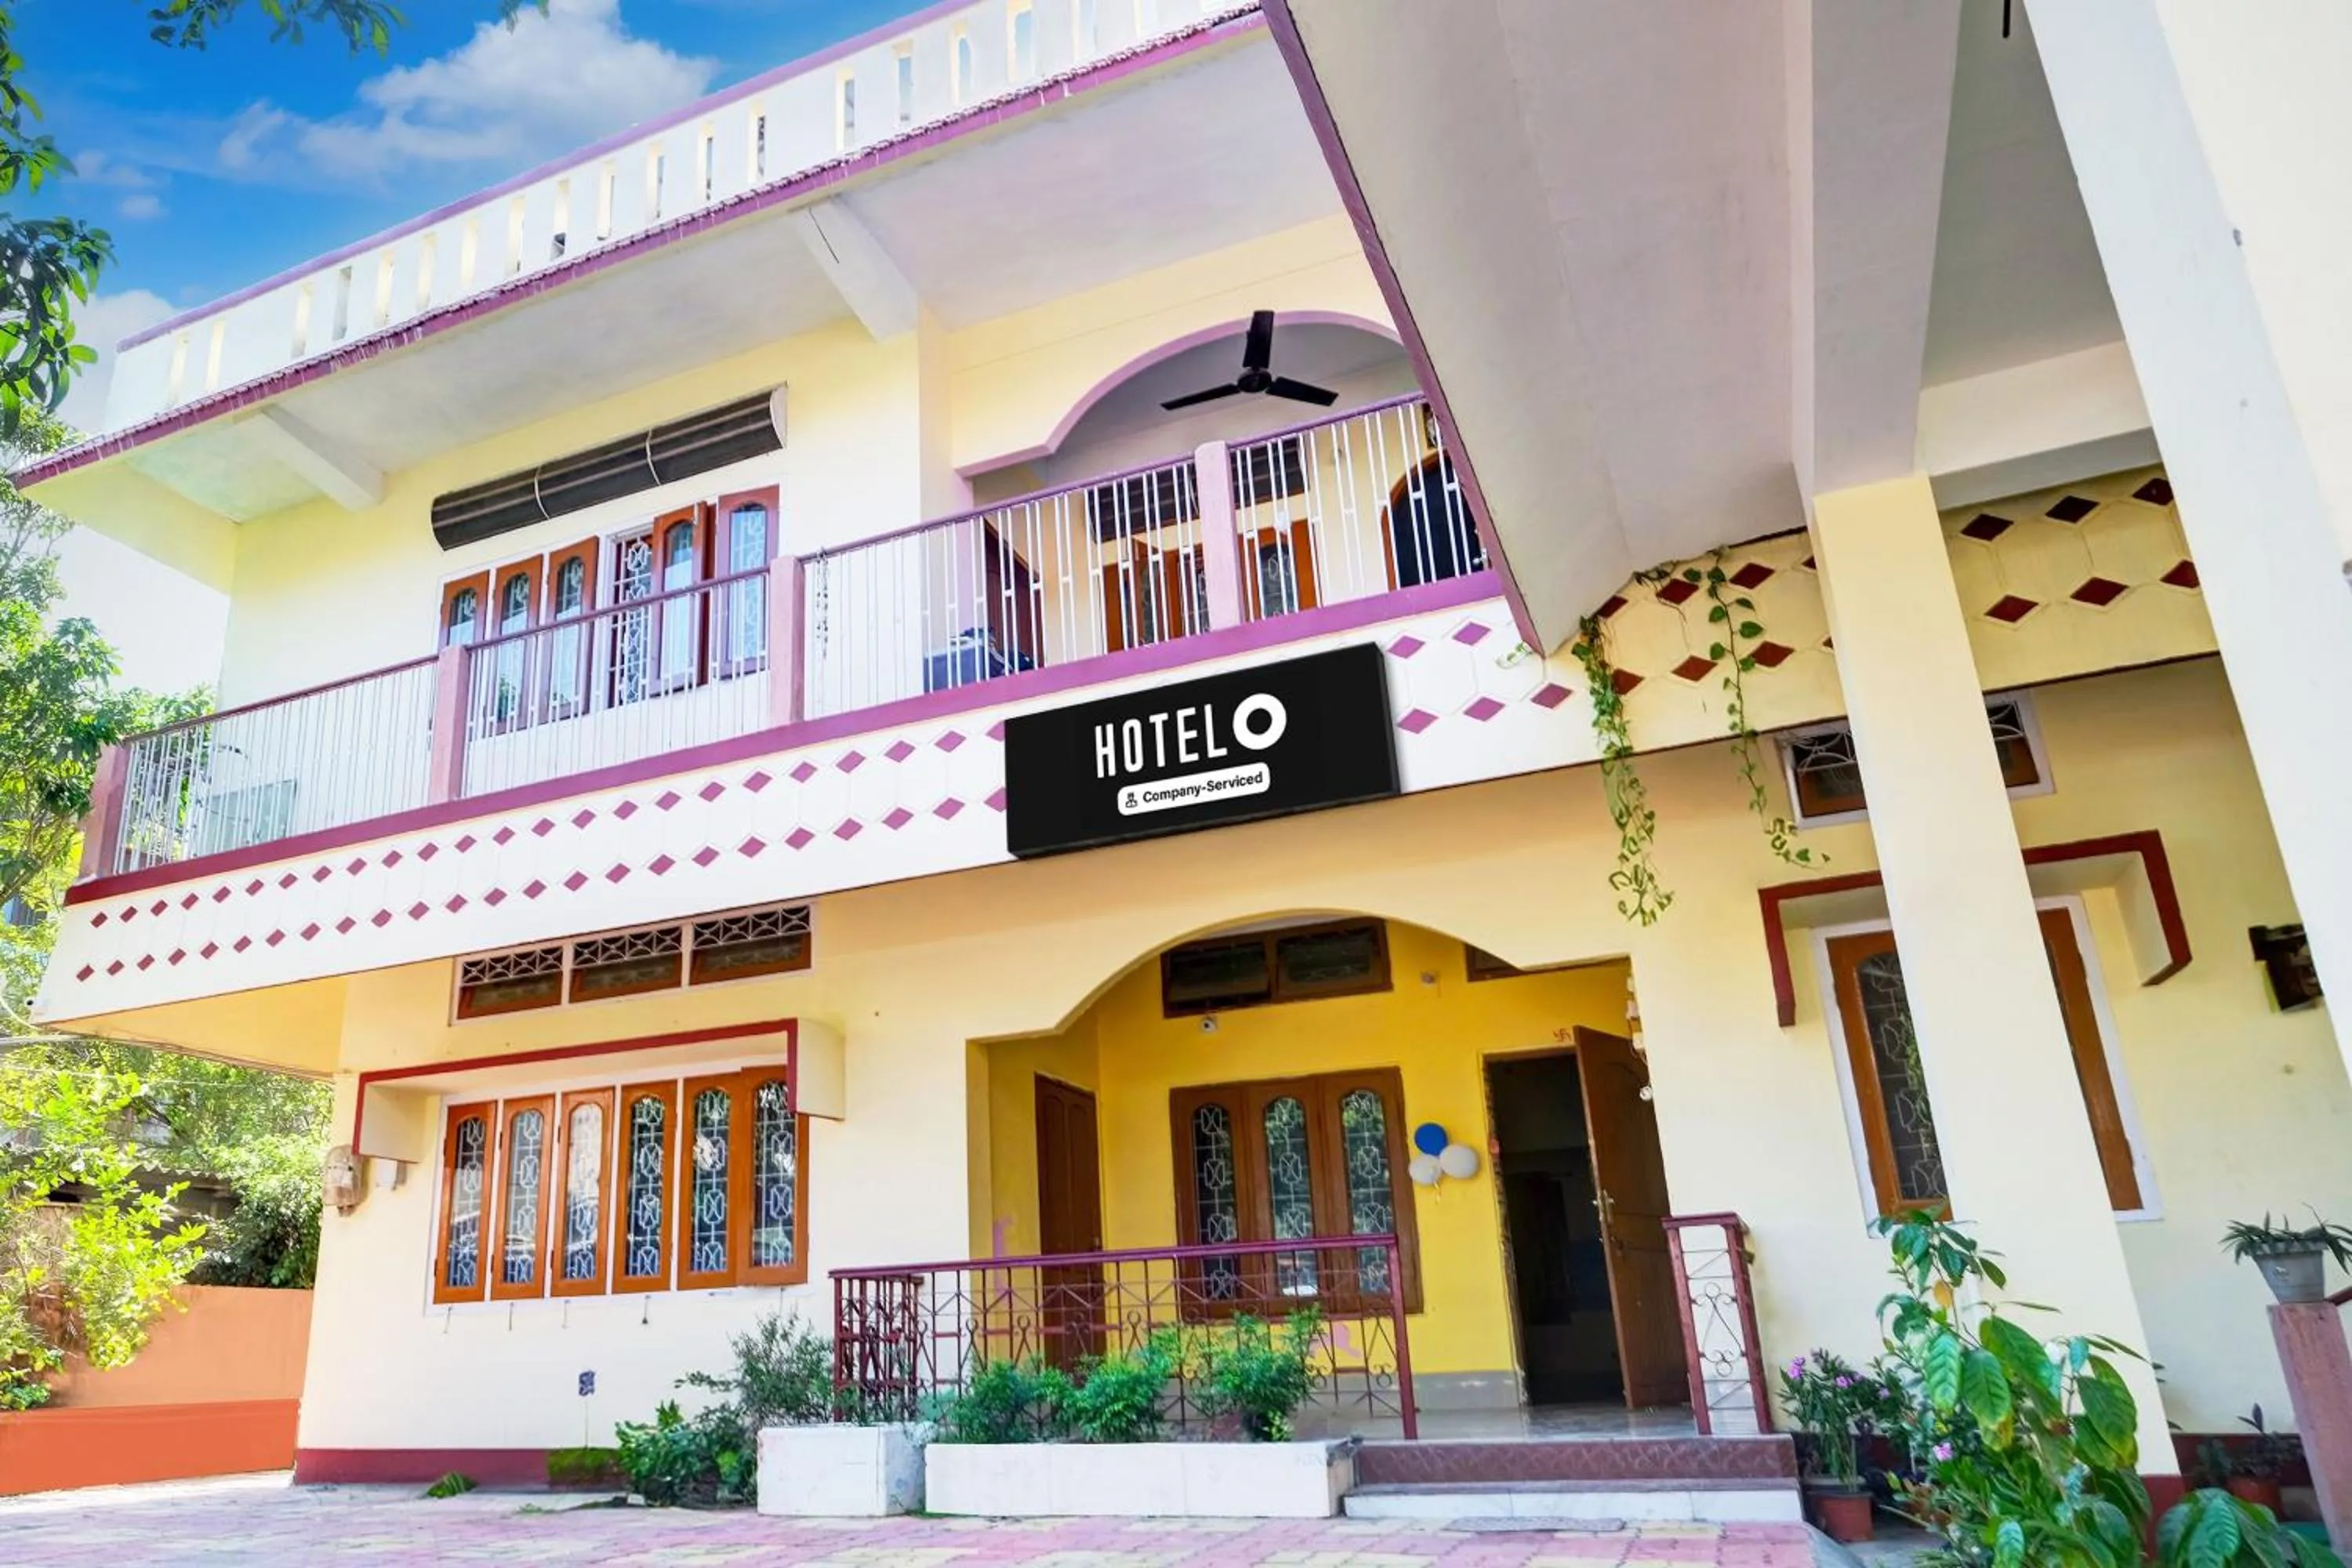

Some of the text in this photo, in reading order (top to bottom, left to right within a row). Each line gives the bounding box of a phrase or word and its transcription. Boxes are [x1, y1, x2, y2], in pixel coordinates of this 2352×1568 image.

[1095, 693, 1287, 779] HOTEL O
[1142, 771, 1264, 803] Company-Serviced
